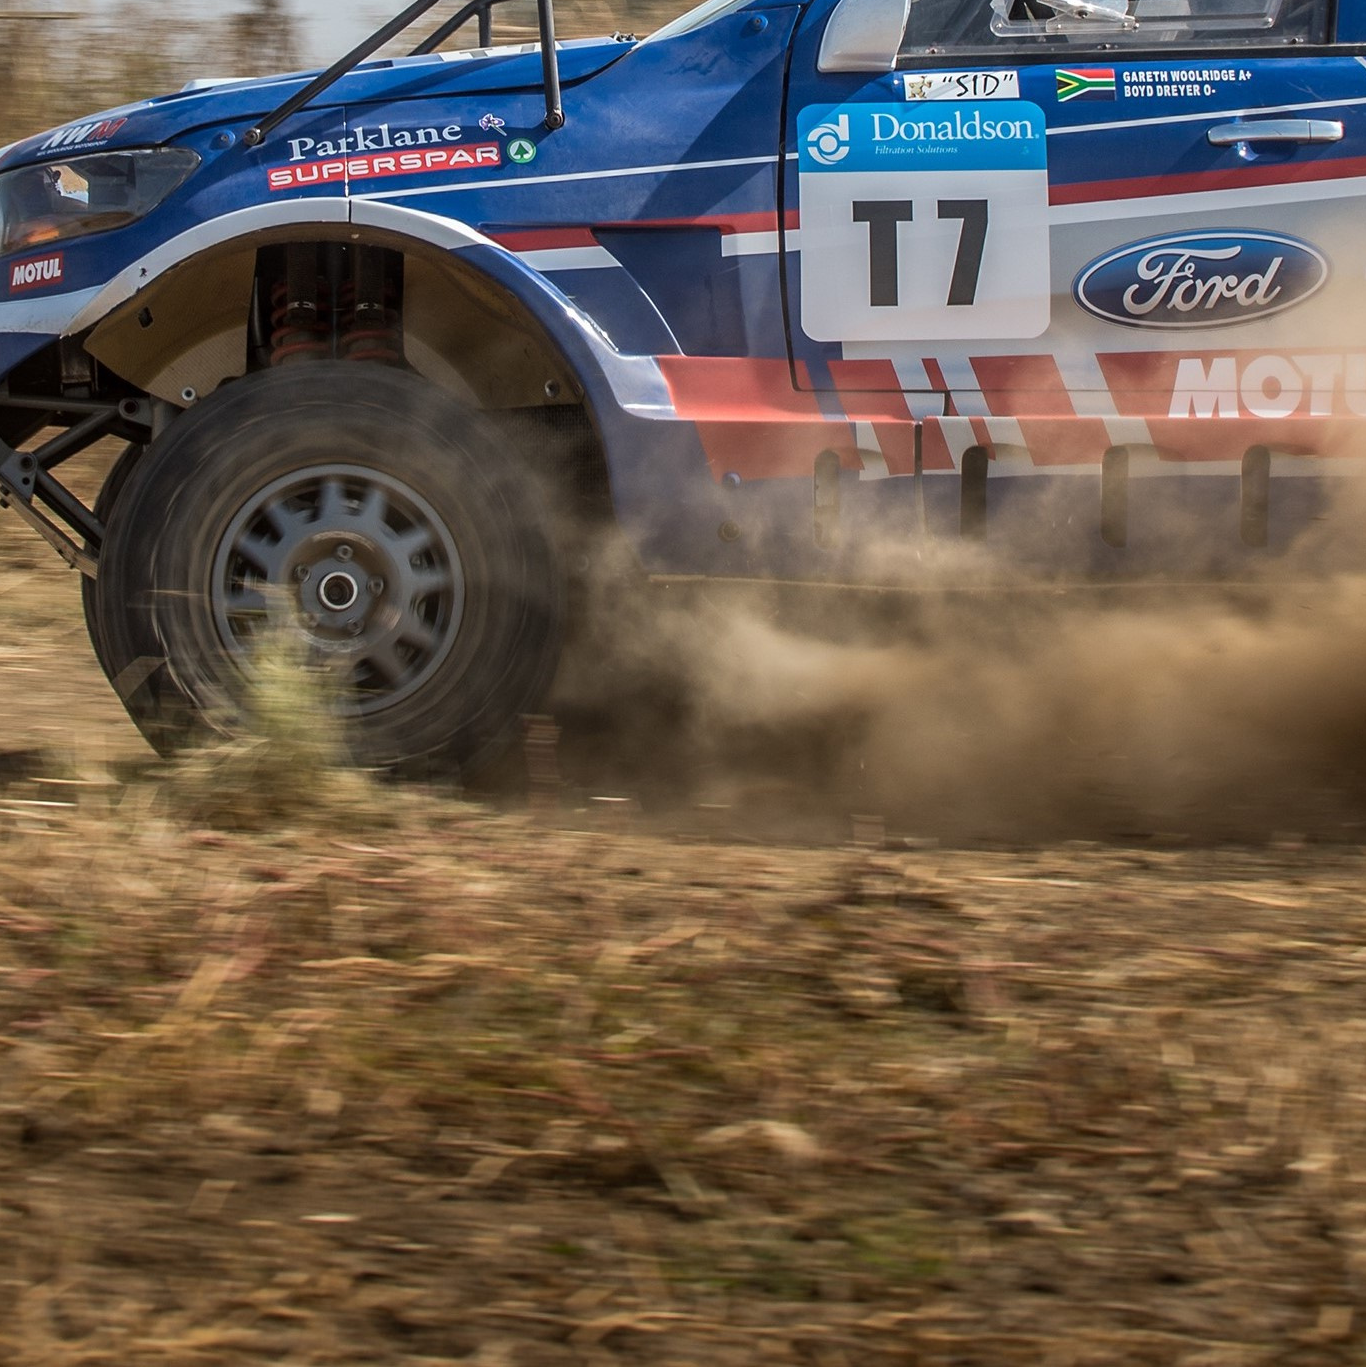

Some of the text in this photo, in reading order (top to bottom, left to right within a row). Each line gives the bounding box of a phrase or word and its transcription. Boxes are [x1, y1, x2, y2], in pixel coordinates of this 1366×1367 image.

[1123, 69, 1252, 82] GARETH WOOLRIDGE A+
[1124, 85, 1154, 97] BOYD
[1156, 84, 1201, 96] DREYER
[40, 117, 128, 150] NWM
[871, 110, 1035, 141] Donaldson
[288, 123, 463, 161] Parklane
[875, 144, 958, 155] Filtration Solutions
[270, 145, 500, 187] SUPERSPAR
[12, 258, 61, 286] MOTUL
[1123, 245, 1282, 315] Ford
